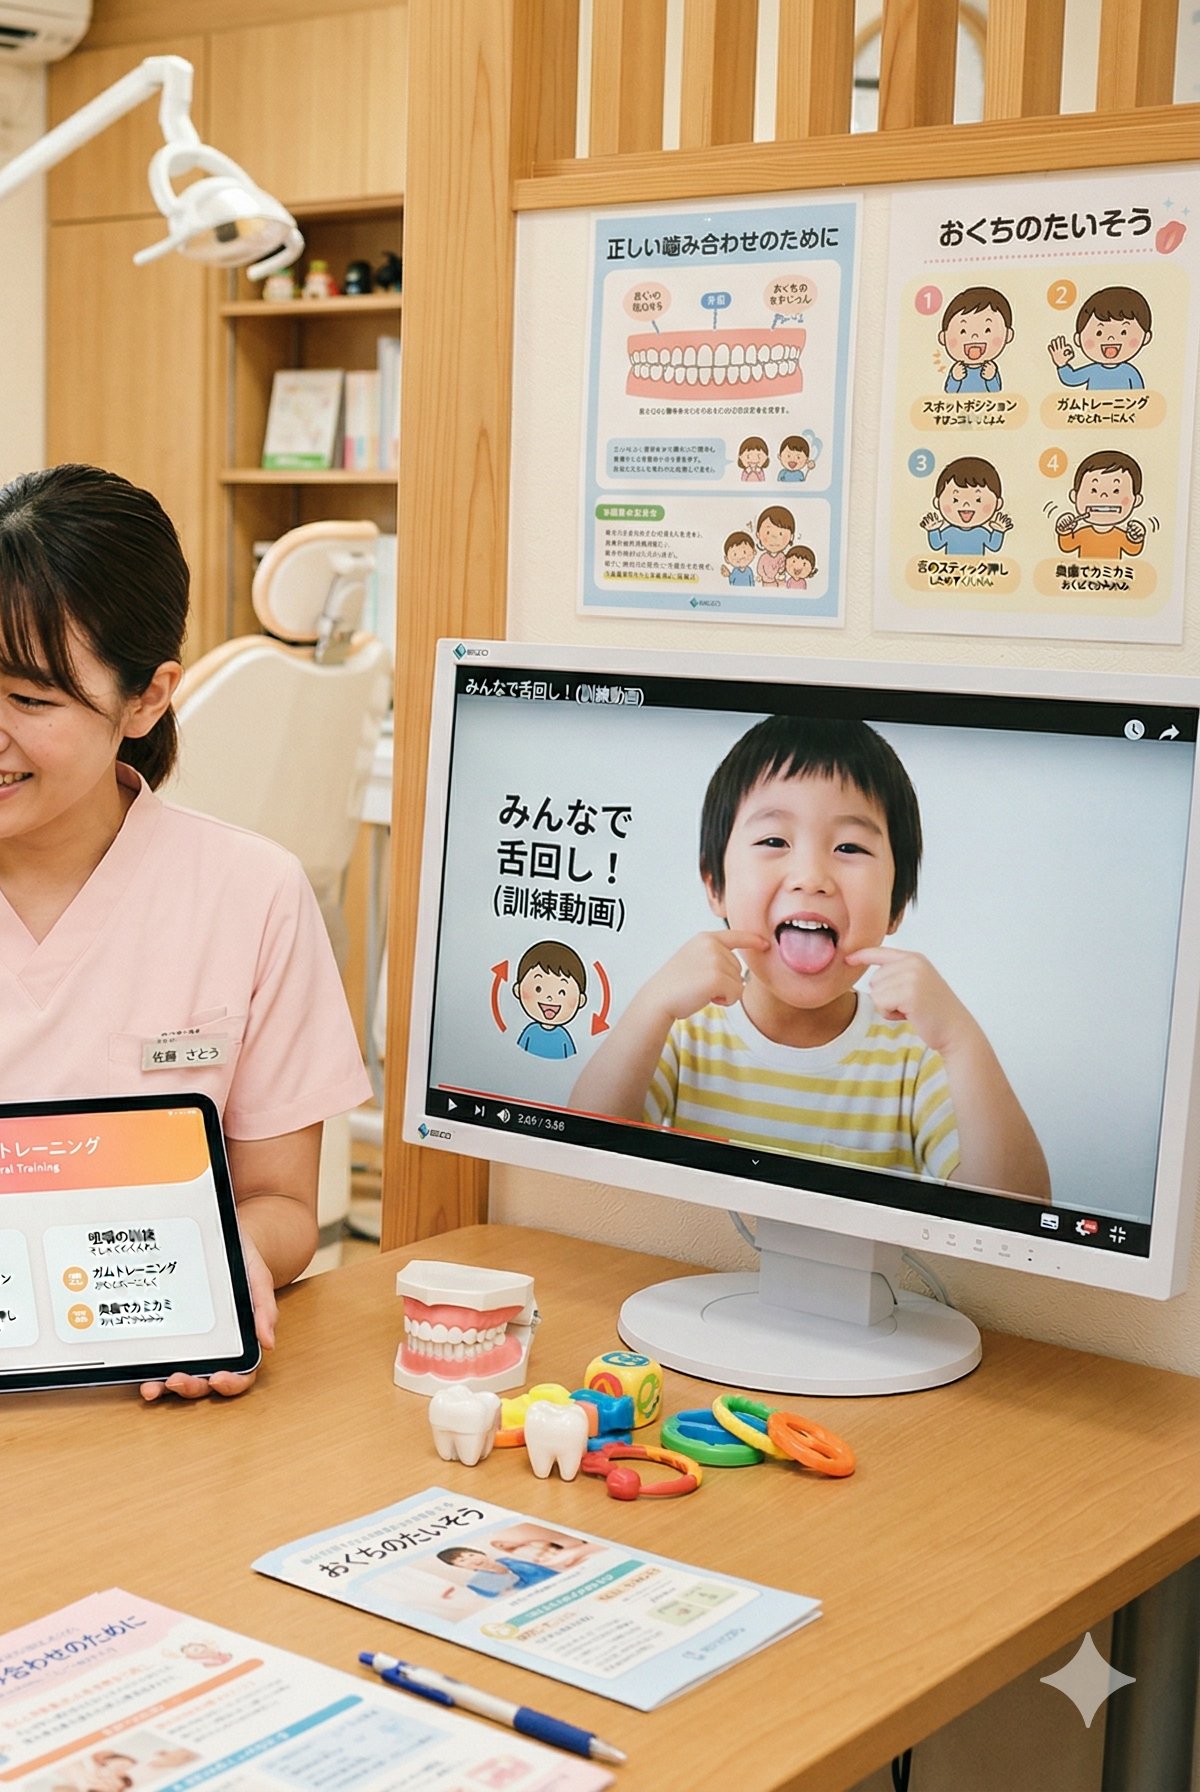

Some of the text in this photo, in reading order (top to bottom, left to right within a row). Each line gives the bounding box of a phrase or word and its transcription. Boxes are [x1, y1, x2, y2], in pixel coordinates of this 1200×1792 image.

[940, 207, 1152, 247] おくちのたいそう
[606, 227, 839, 260] 正しい噛み合わせのために
[922, 292, 933, 309] 1
[1055, 286, 1068, 304] 2
[1057, 395, 1150, 411] ガムトレーニング
[916, 455, 927, 472] 3
[1046, 454, 1058, 472] 4
[498, 794, 633, 839] みんなで
[497, 839, 618, 884] 舌回し！
[493, 884, 626, 932] (訓練動画)
[186, 1047, 219, 1061] さとう
[16, 1162, 60, 1174] Training
[319, 1506, 485, 1578] おくちのたいそう
